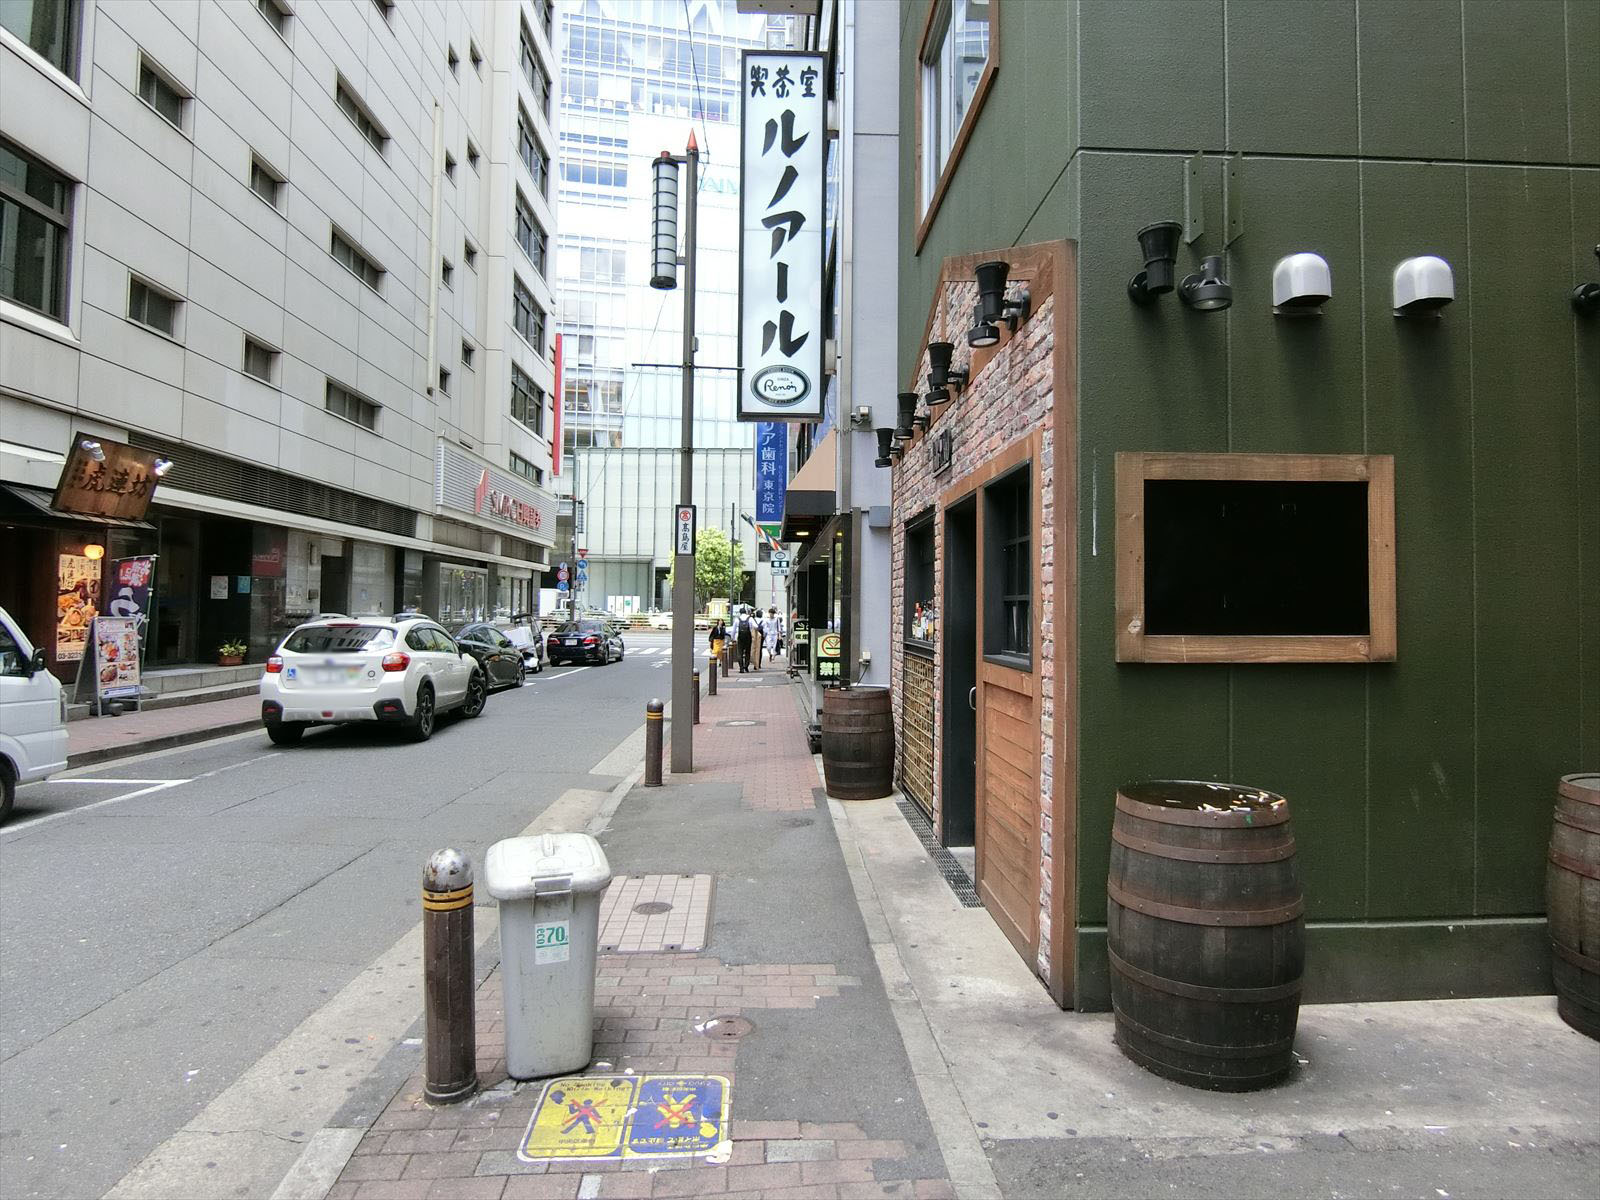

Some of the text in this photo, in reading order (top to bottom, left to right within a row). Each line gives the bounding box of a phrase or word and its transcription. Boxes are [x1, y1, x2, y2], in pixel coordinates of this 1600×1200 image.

[750, 64, 819, 99] 喫茶室
[761, 108, 811, 358] ルノアール
[761, 479, 775, 514] 東京院
[546, 927, 566, 943] 70
